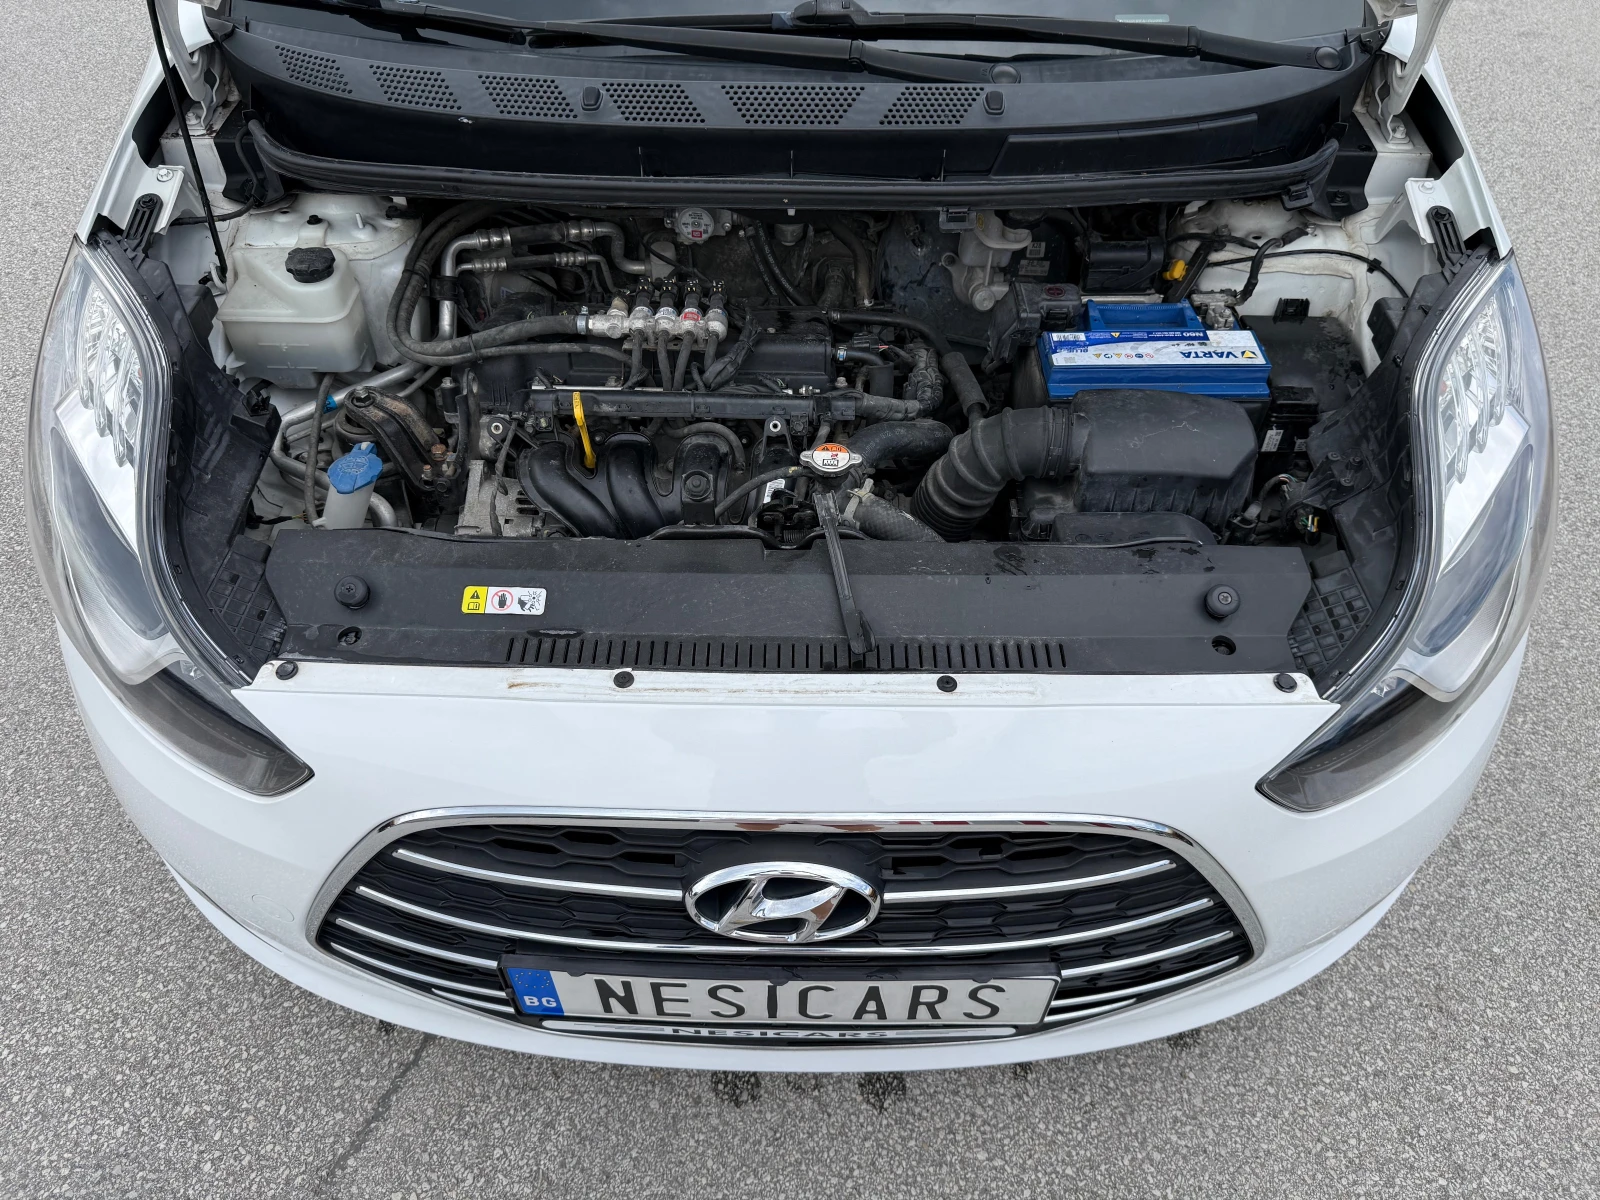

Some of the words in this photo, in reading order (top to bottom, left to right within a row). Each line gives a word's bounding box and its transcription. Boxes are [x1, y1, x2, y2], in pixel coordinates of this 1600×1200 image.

[1180, 351, 1239, 359] VARTA
[523, 995, 557, 1008] BG
[594, 978, 1006, 1020] NESICARS
[671, 1028, 888, 1038] NESICARS
